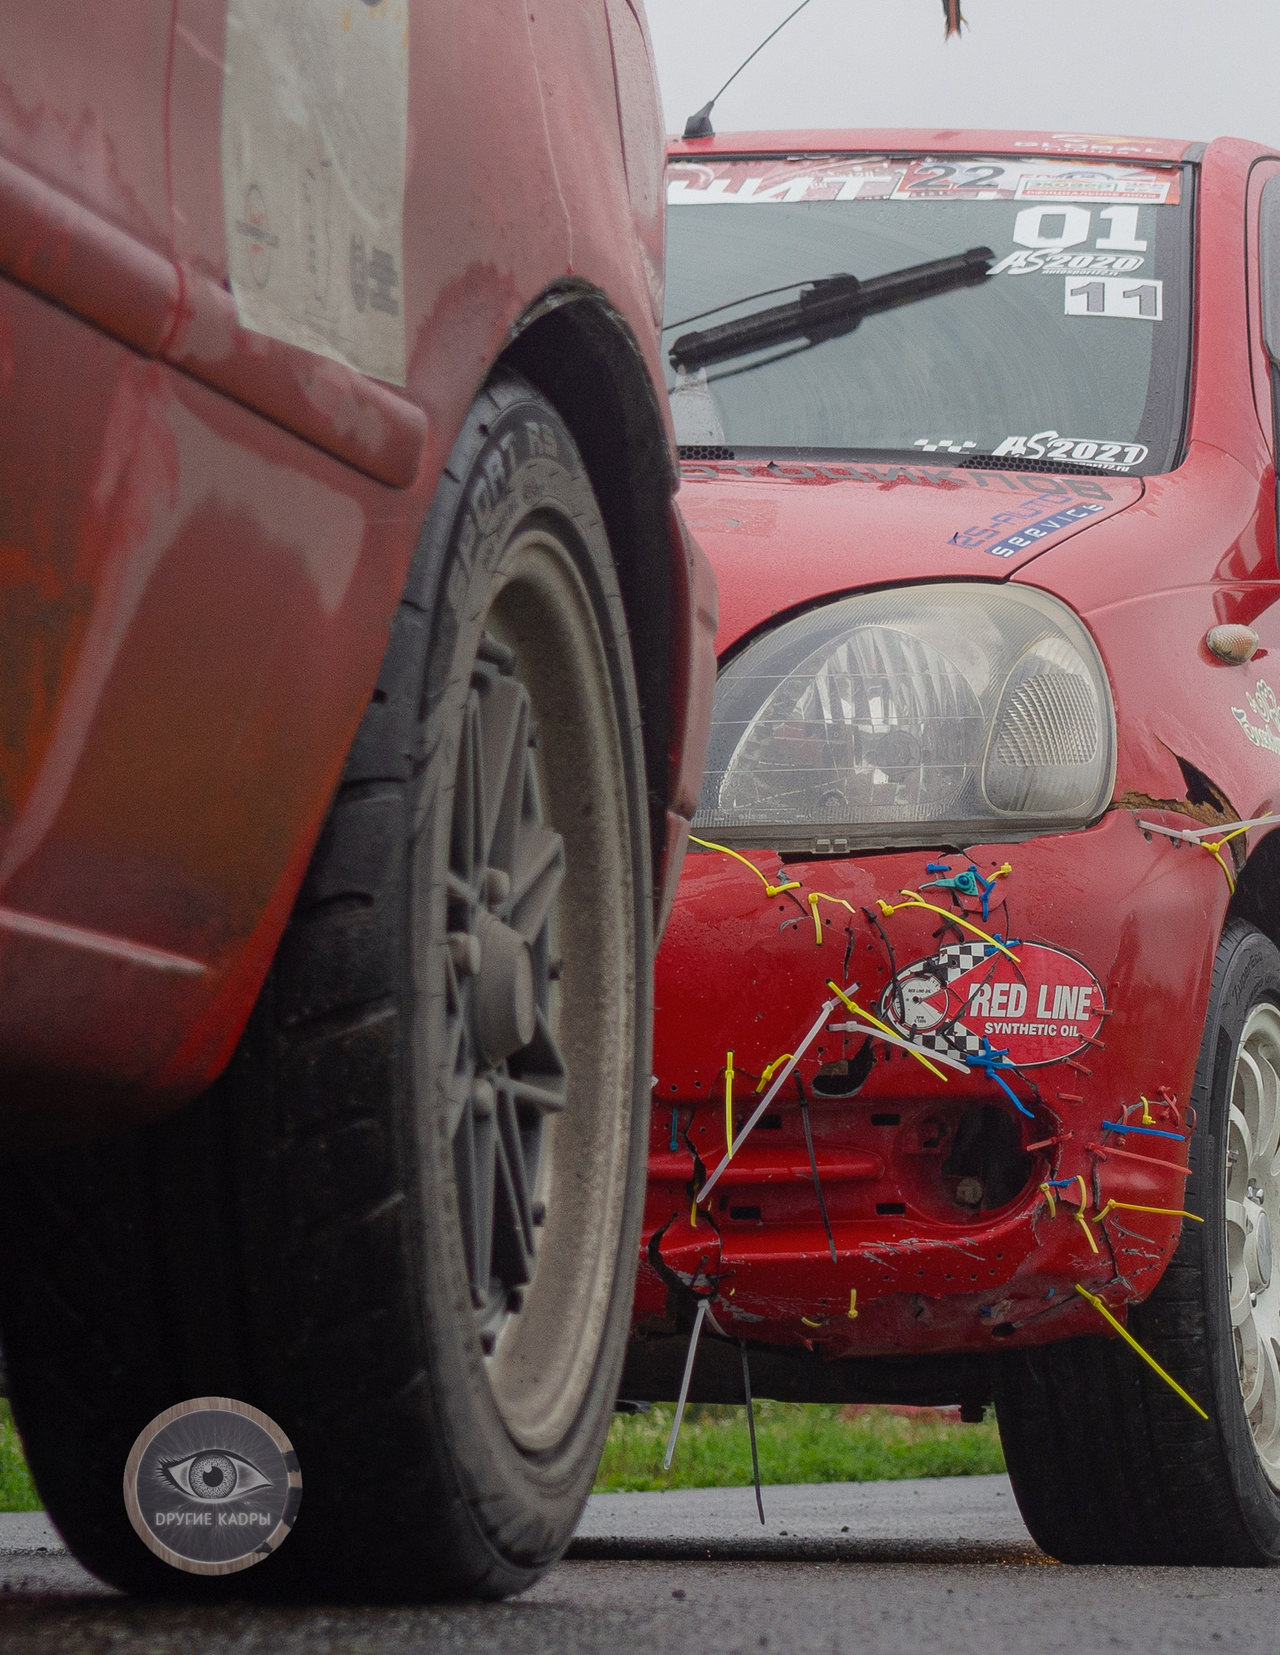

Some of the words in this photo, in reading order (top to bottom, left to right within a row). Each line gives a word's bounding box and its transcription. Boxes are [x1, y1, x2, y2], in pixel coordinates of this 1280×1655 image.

[906, 165, 1005, 190] 22
[1012, 205, 1148, 252] 01
[985, 247, 1145, 276] AS2020
[1070, 281, 1158, 317] 11
[991, 430, 1149, 466] AS2021
[967, 983, 1028, 1018] RED
[1036, 984, 1094, 1021] LINE
[984, 1022, 1057, 1036] SYNTHETIC
[1061, 1024, 1080, 1038] OIL
